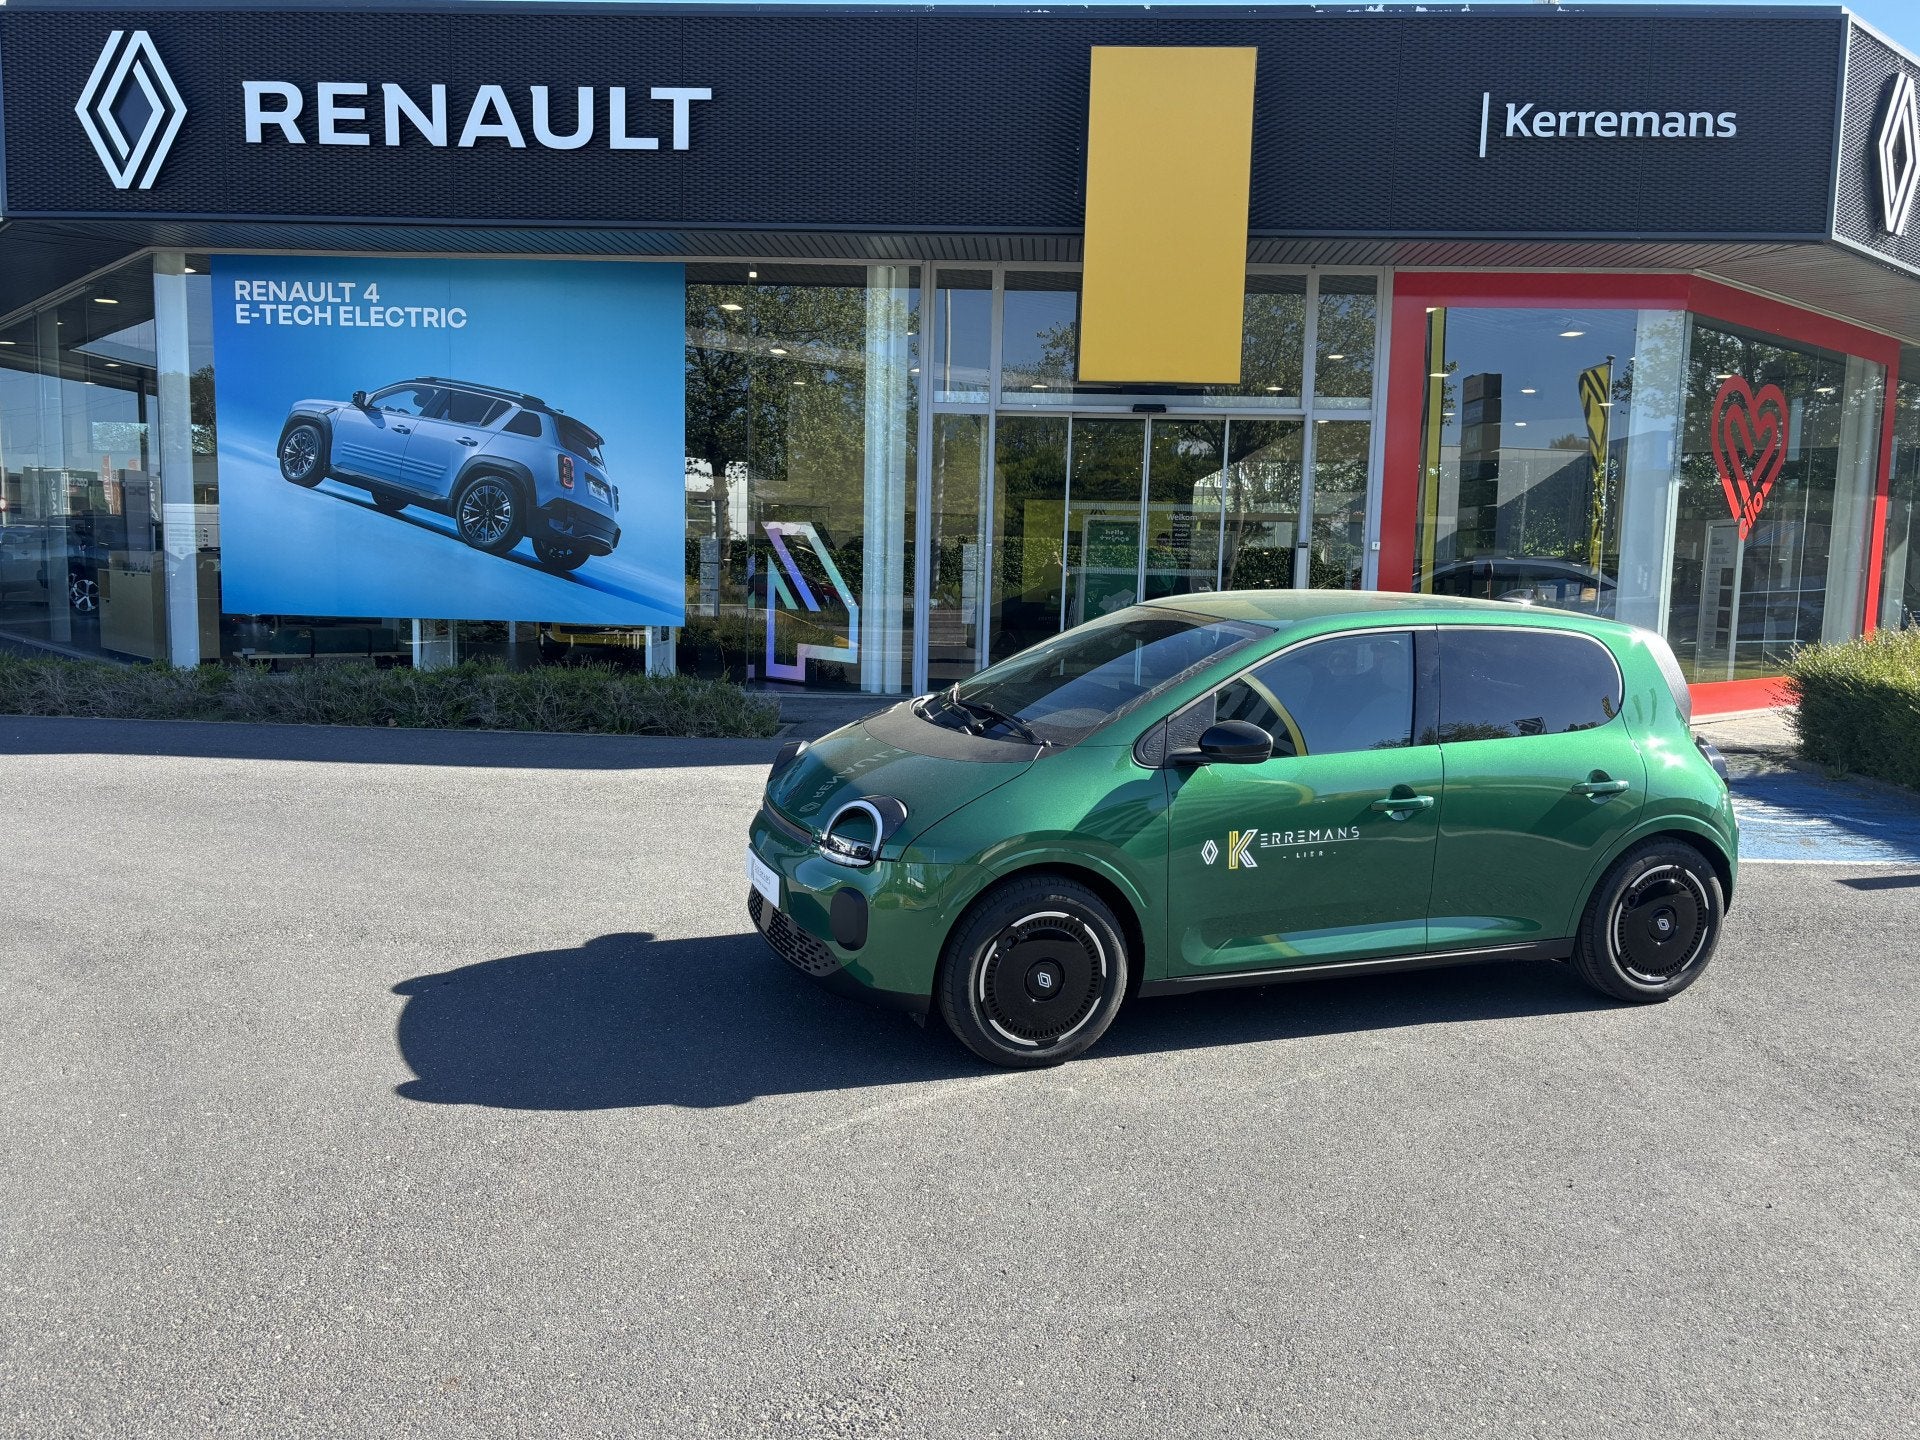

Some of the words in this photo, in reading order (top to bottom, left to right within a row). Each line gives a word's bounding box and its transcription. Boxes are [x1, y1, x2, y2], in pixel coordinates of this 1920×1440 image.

[242, 80, 713, 150] RENAULT
[1505, 102, 1737, 138] Kerremans
[234, 280, 356, 303] RENAULT
[363, 283, 380, 303] 4
[235, 303, 332, 326] E-TECH
[339, 306, 468, 329] ELECTRIC
[1166, 513, 1198, 521] Welkom
[1296, 851, 1324, 859] LIER
